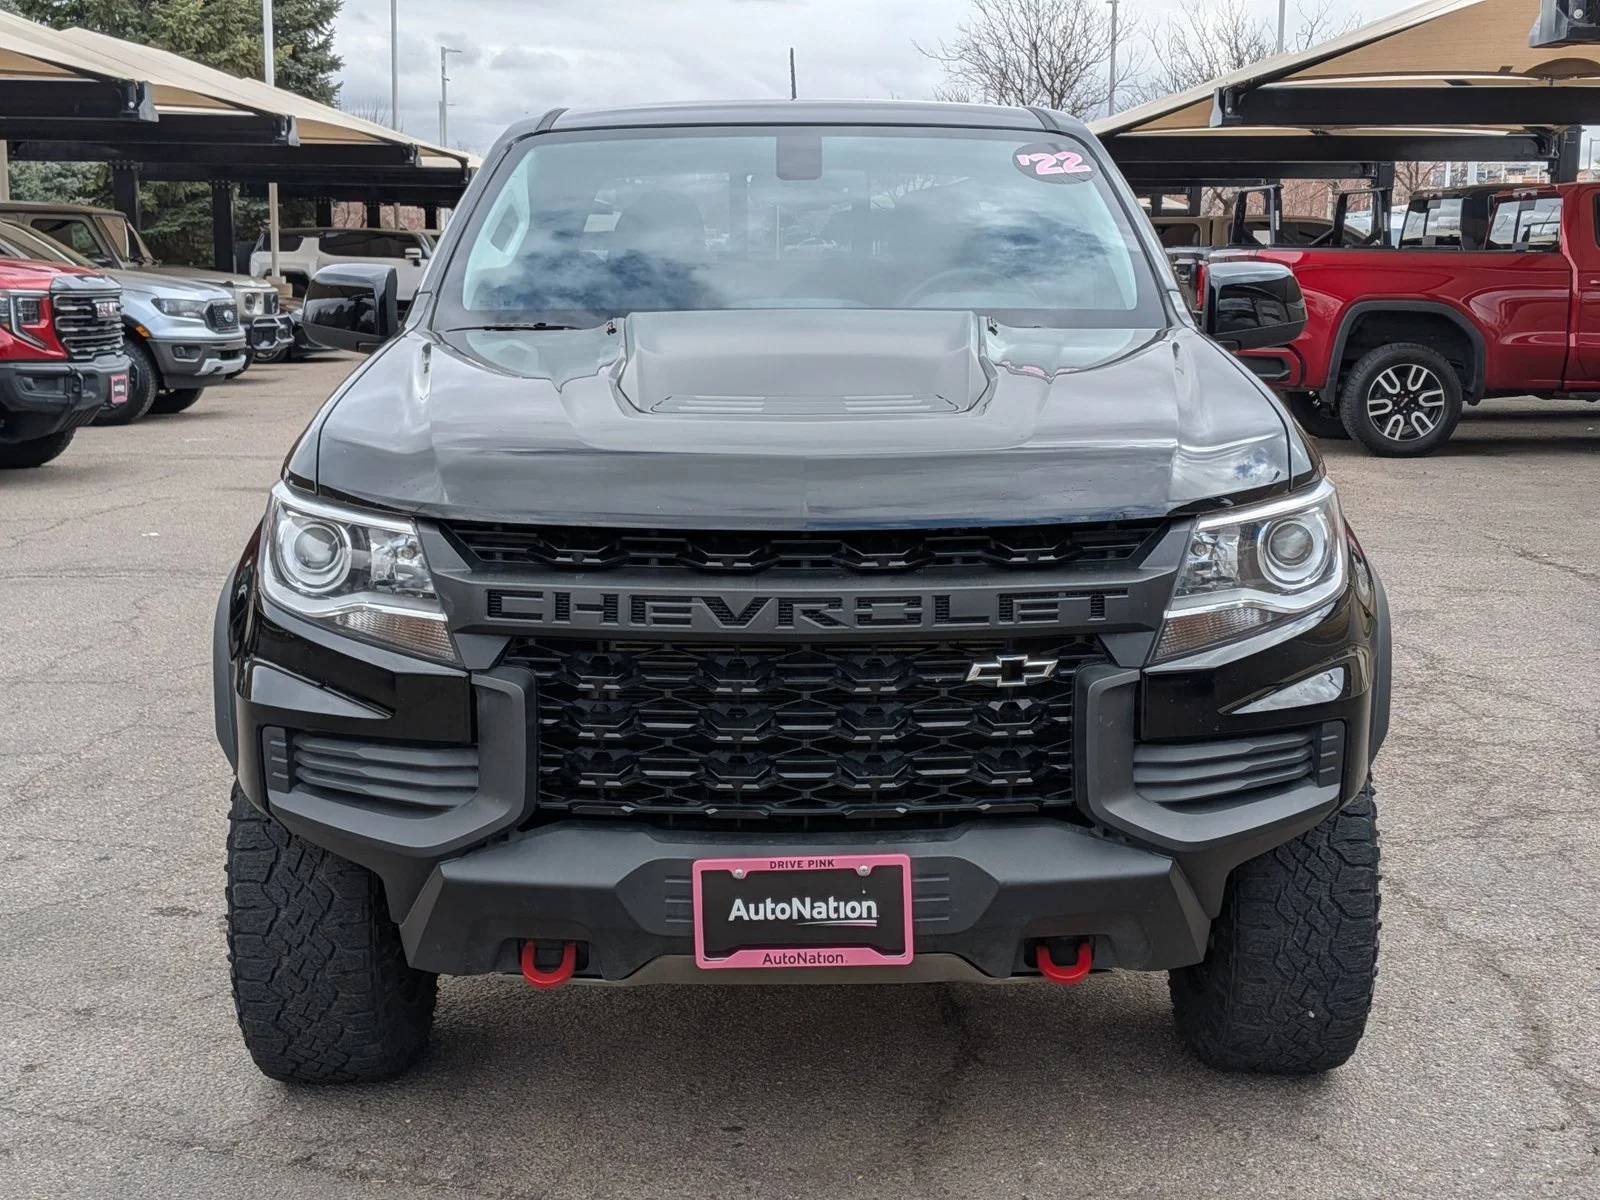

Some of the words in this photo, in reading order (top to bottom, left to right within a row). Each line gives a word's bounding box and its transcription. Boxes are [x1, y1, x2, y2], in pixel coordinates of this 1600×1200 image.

[486, 587, 1130, 629] CHEVROLET
[769, 860, 804, 869] DRIVE
[807, 859, 835, 868] PINK
[728, 896, 880, 921] AutoNation
[762, 951, 848, 965] AutoNation
